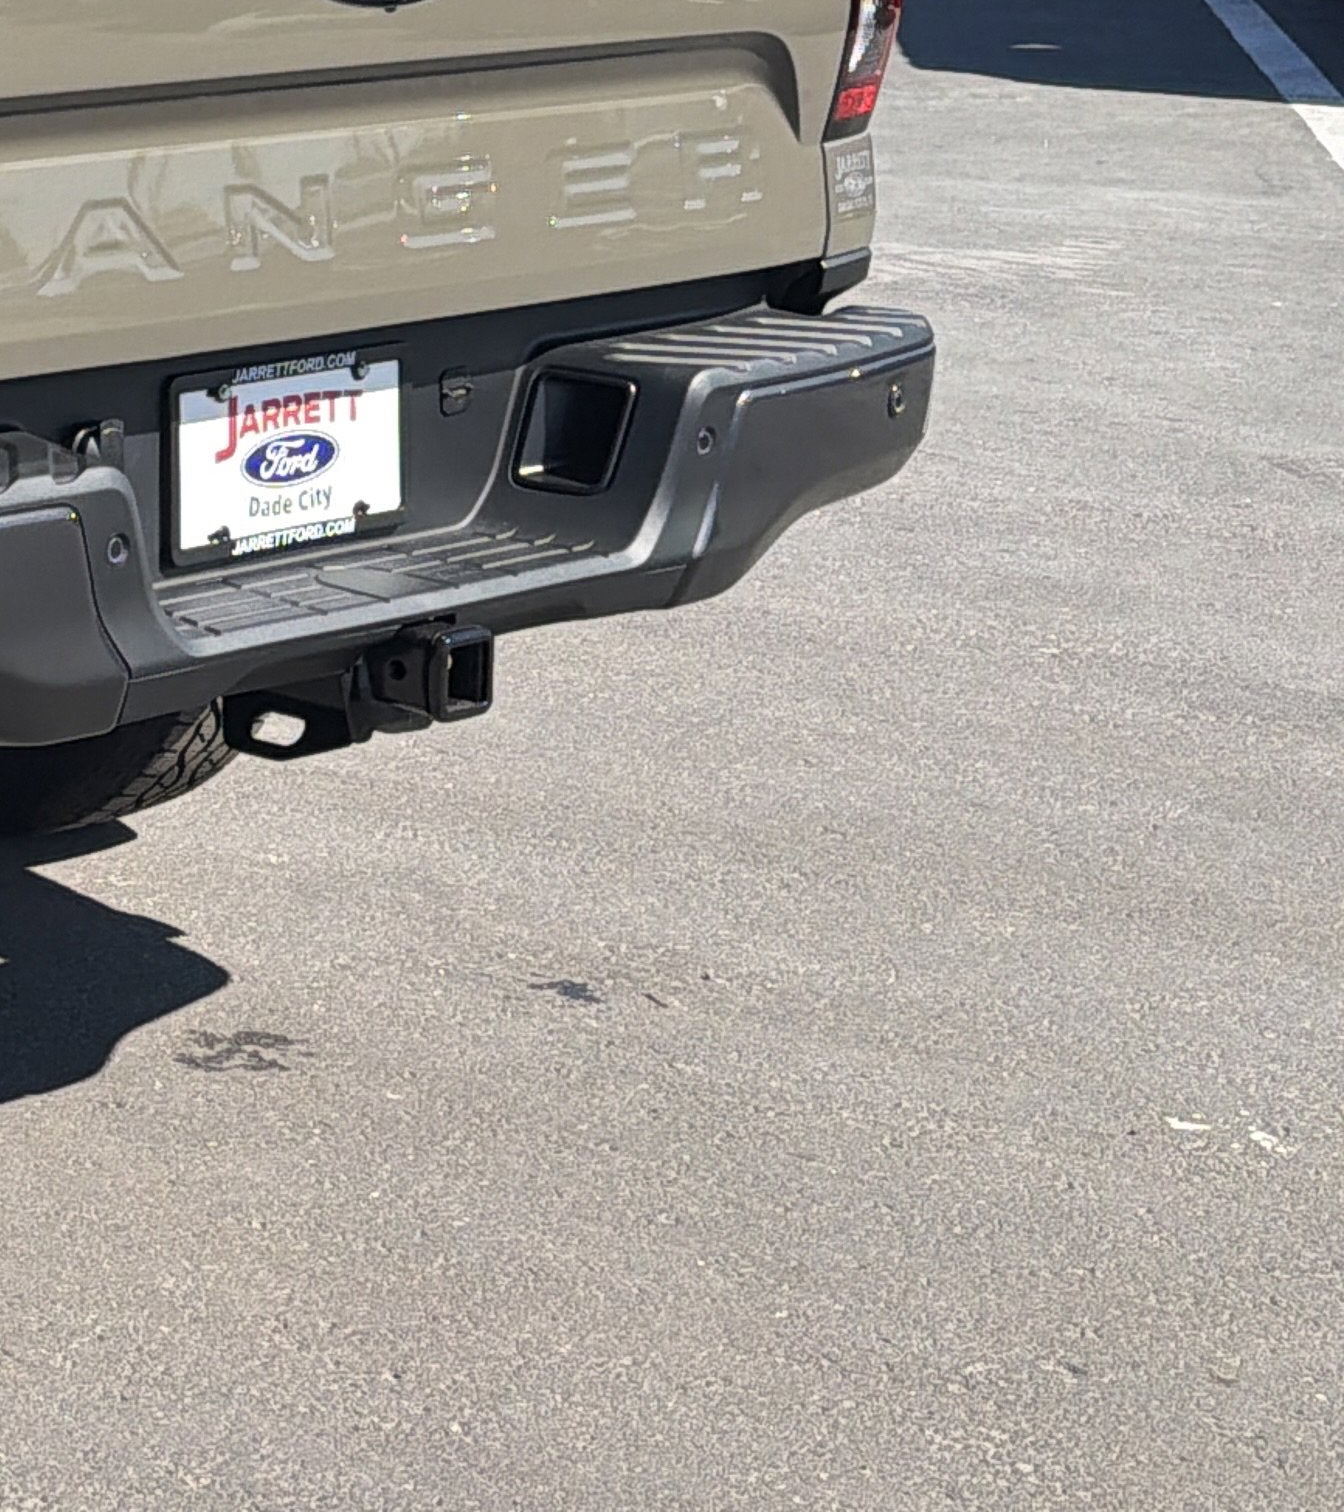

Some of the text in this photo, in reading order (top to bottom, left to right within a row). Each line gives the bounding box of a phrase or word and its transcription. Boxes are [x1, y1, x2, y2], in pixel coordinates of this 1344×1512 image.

[232, 351, 357, 384] JARRETTFORD.COM
[215, 389, 363, 463] JARRETT
[249, 486, 332, 517] Dade City
[232, 518, 356, 556] JARRETTFORD.COM
